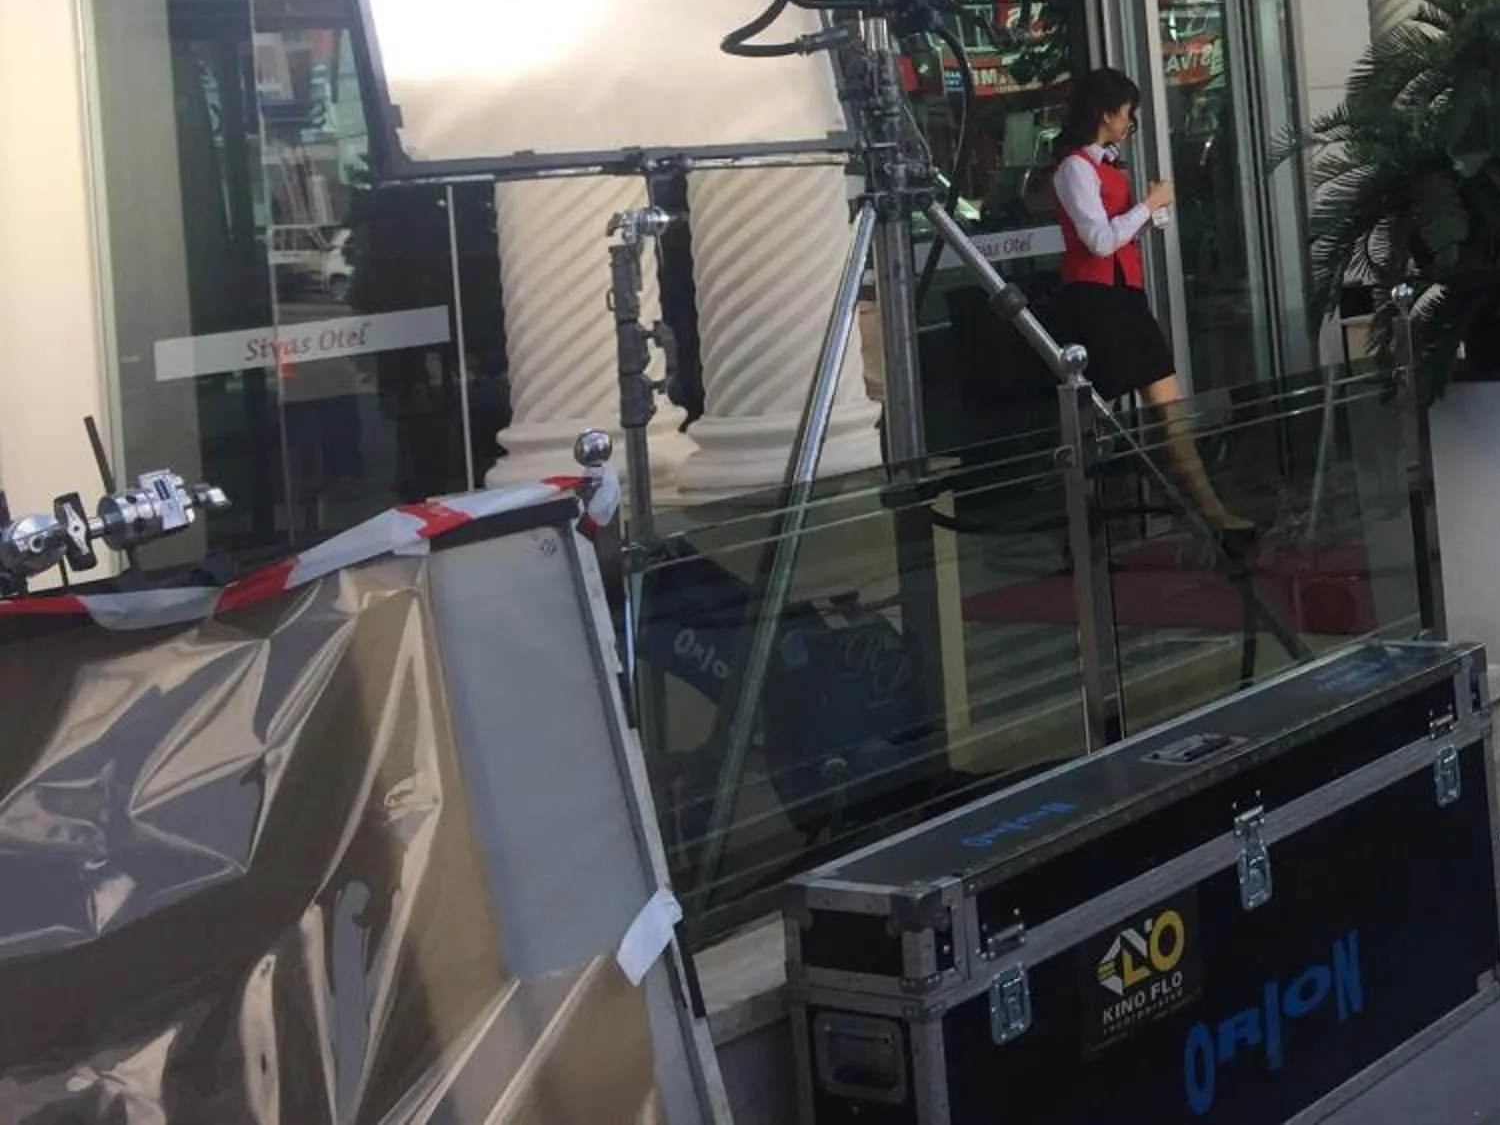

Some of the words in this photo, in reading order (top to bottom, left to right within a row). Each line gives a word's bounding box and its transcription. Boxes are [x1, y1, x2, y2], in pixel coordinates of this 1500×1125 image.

[244, 337, 313, 361] Sivas
[319, 321, 371, 351] Otel
[1103, 990, 1146, 1025] KINO
[1151, 971, 1183, 1001] FLO
[1184, 928, 1363, 1115] ORION
